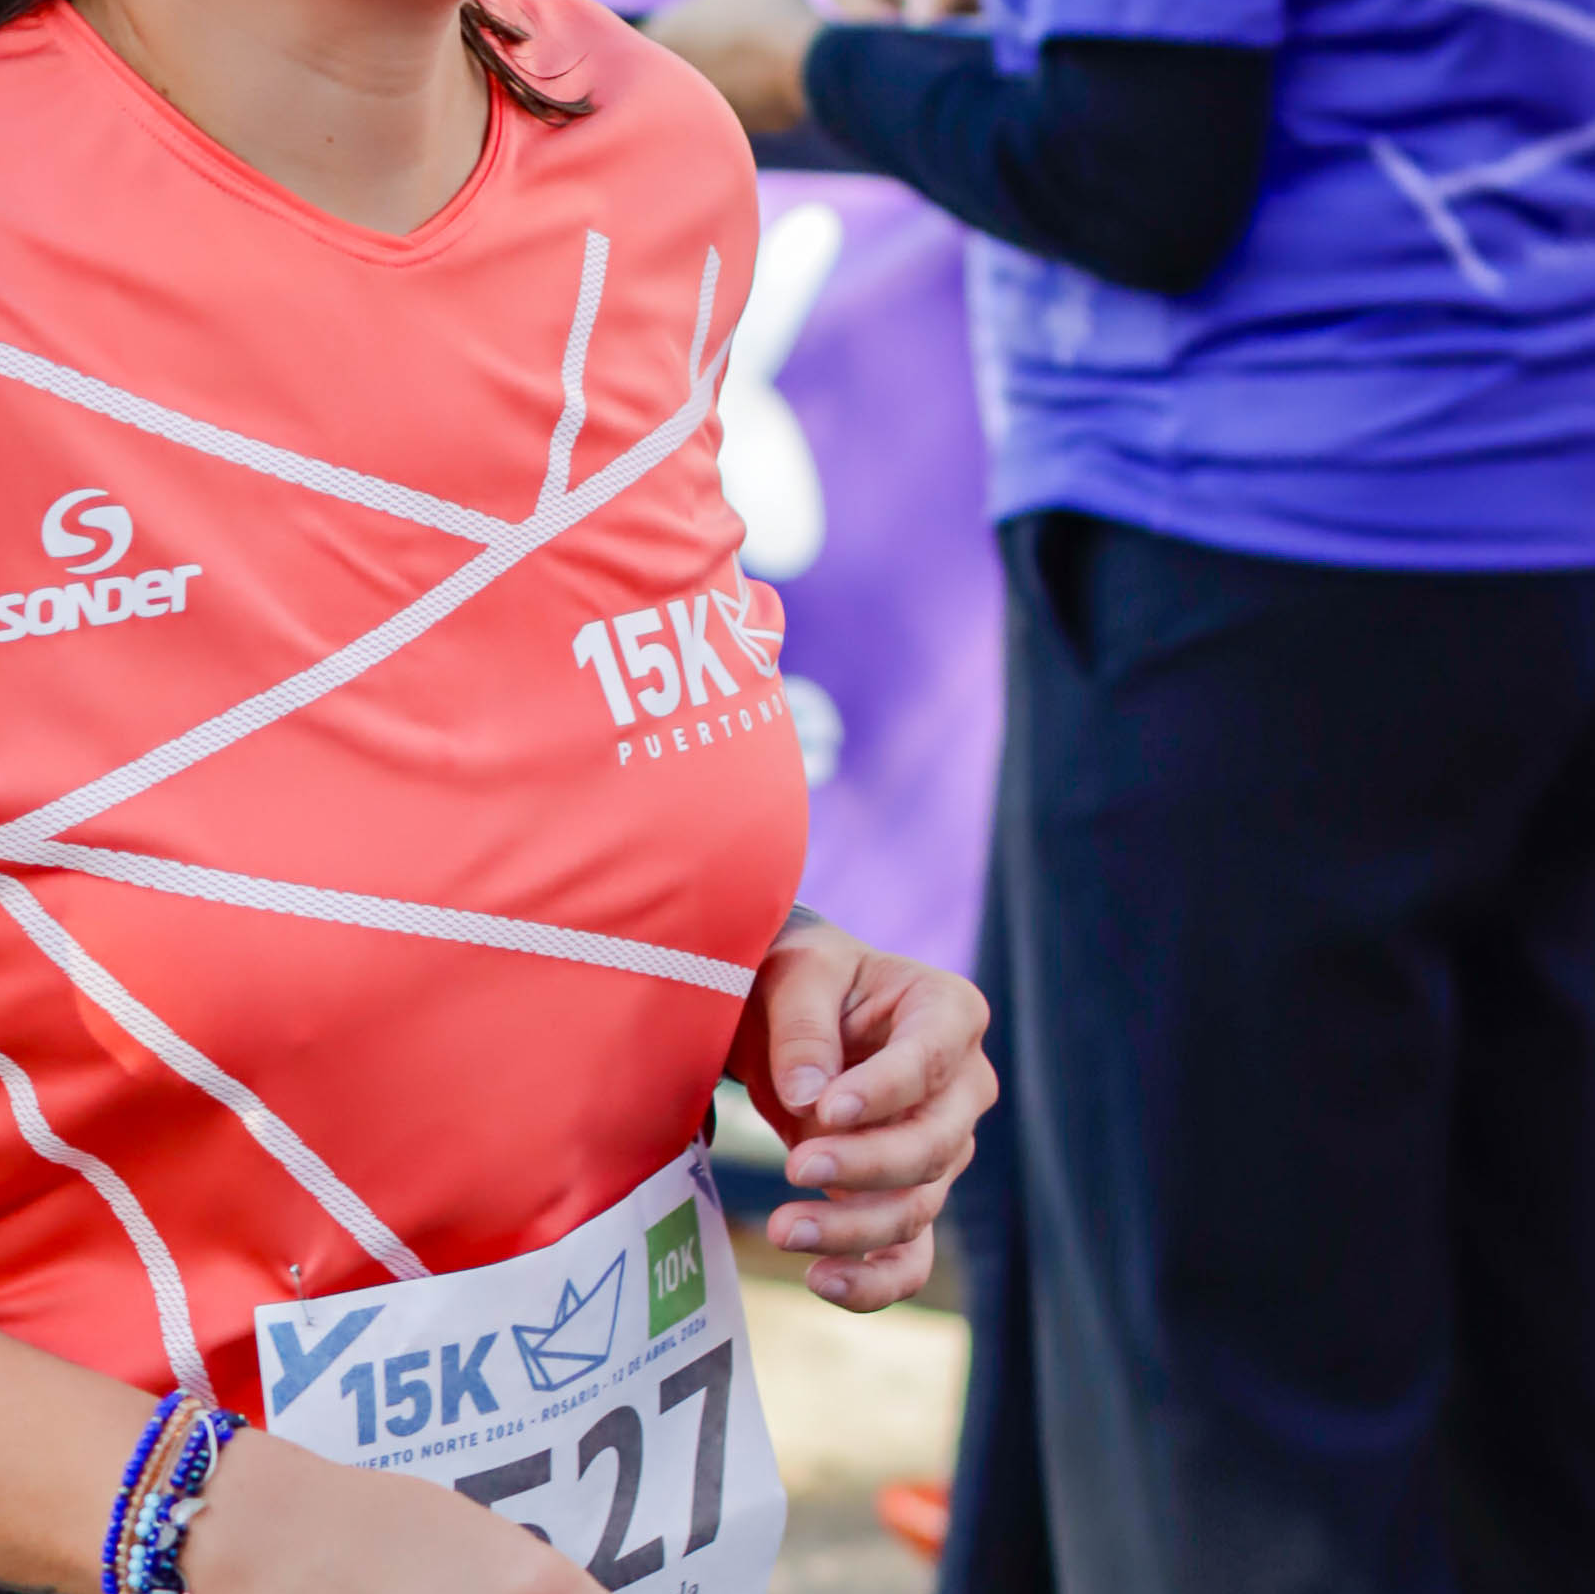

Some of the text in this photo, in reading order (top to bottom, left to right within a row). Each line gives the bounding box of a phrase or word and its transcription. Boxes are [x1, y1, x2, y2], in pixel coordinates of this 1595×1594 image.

[571, 593, 741, 727] 15K
[617, 708, 753, 766] PUERTO
[653, 1236, 698, 1300] 10K
[339, 1331, 501, 1447] 15K
[352, 1448, 414, 1471] ERTO
[420, 1432, 479, 1459] NORTE
[485, 1419, 525, 1443] 2026
[541, 1383, 600, 1422] ROSARIO
[612, 1367, 624, 1385] 12
[628, 1356, 642, 1376] DE
[644, 1335, 677, 1365] ABRIL
